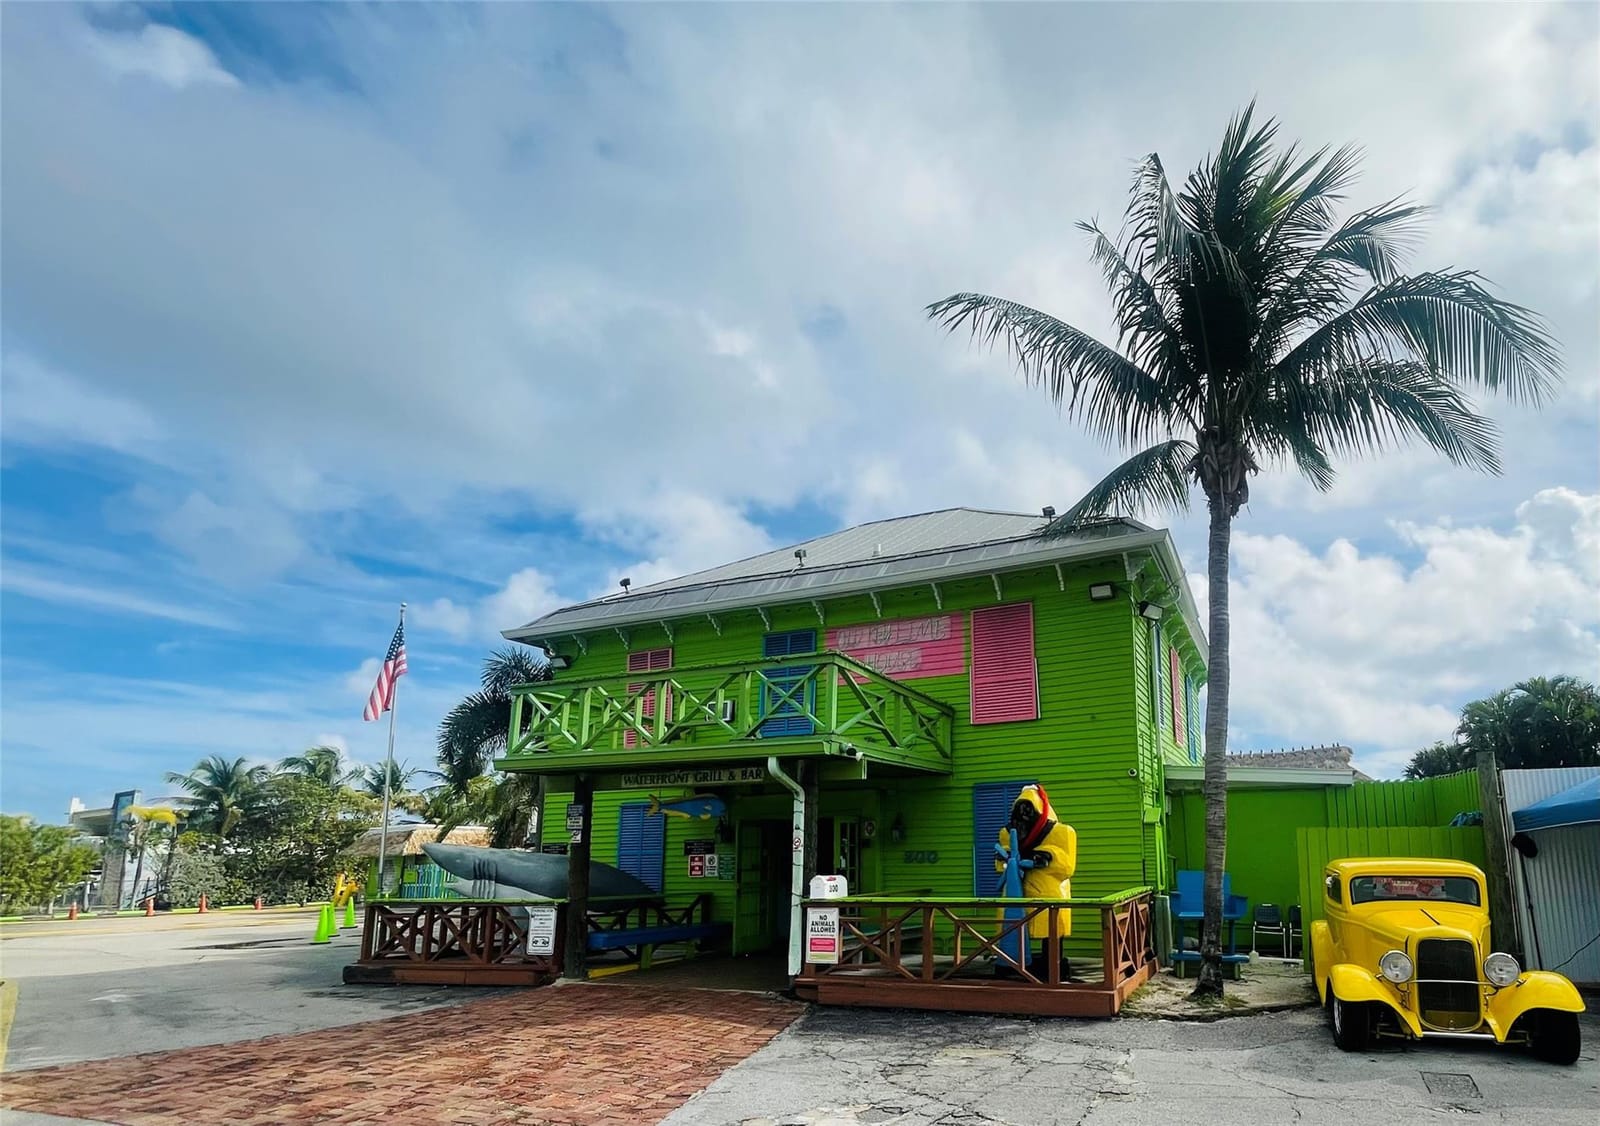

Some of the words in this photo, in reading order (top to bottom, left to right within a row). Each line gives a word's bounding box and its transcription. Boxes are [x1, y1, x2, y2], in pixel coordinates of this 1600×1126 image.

[623, 772, 689, 785] WATERFRONT
[694, 769, 723, 782] GRILL
[728, 769, 736, 780] &
[741, 767, 763, 780] BAR
